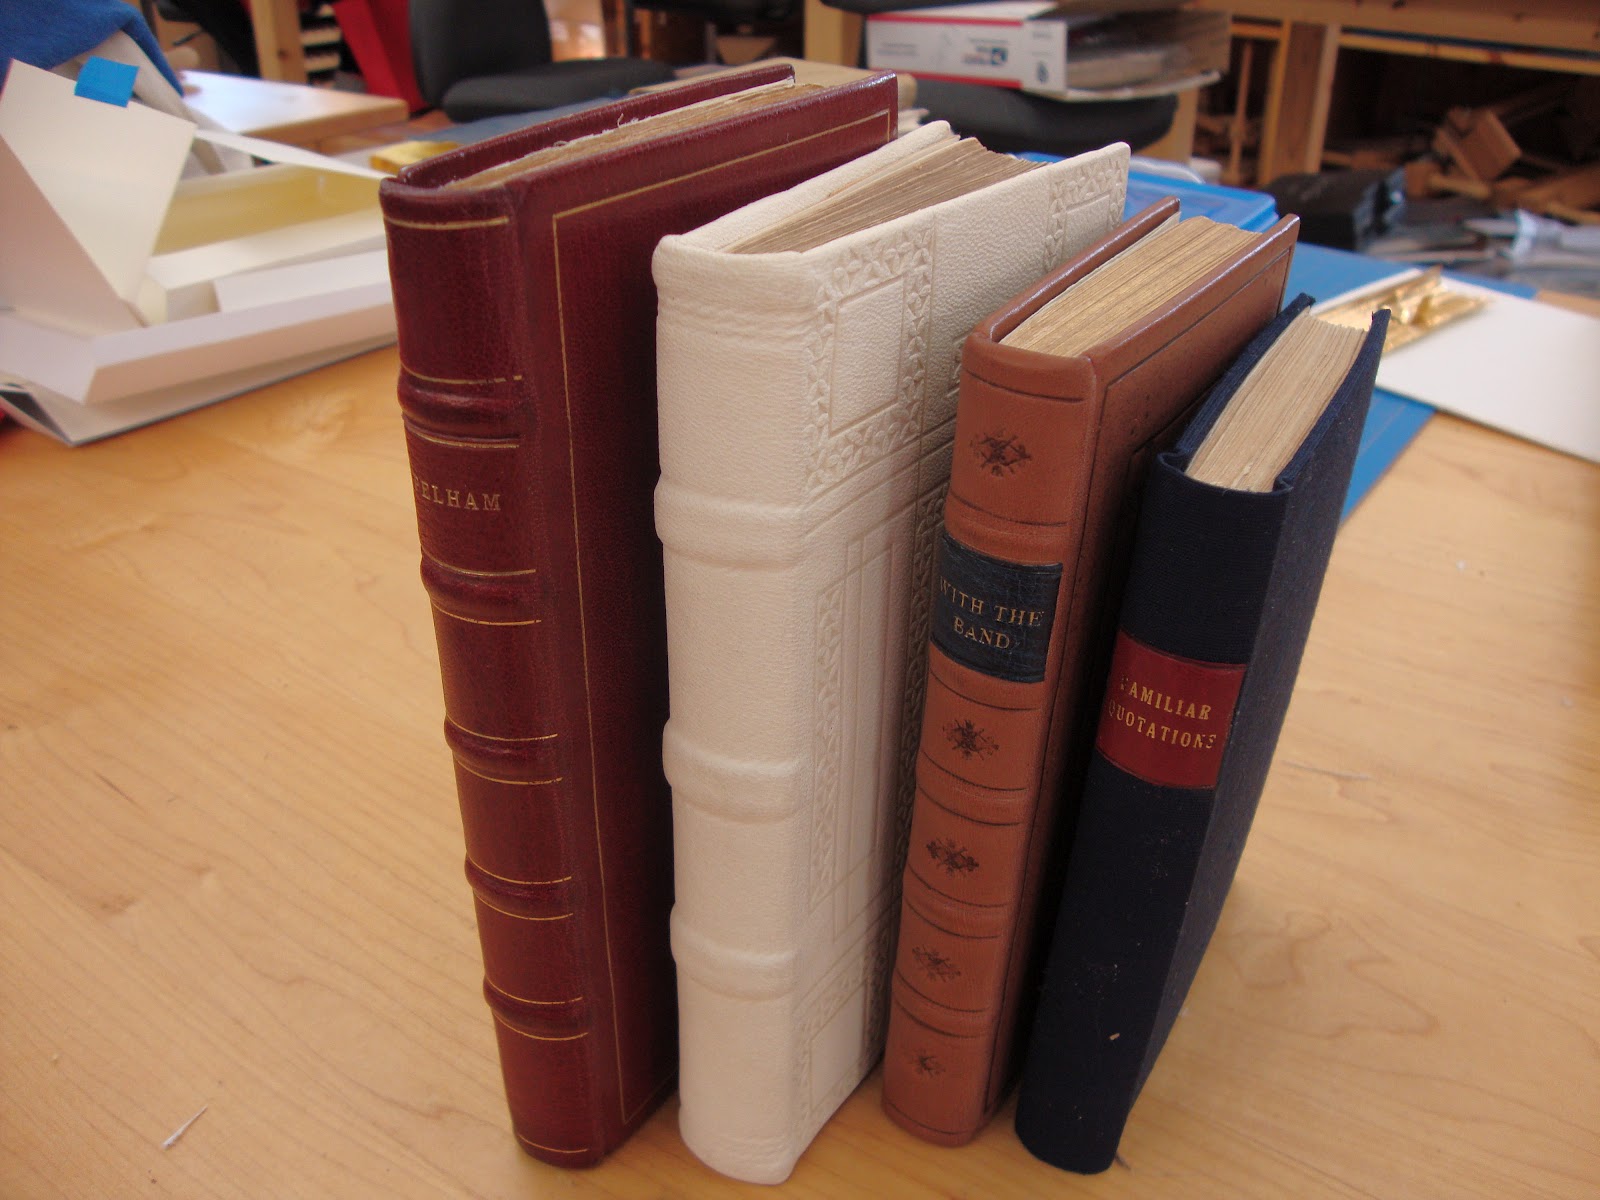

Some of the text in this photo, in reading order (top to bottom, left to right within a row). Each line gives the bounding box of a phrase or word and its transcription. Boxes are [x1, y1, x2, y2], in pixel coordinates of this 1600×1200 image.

[953, 614, 1010, 649] BAND
[994, 605, 1045, 627] THE
[1108, 699, 1217, 749] QUOTATIONS
